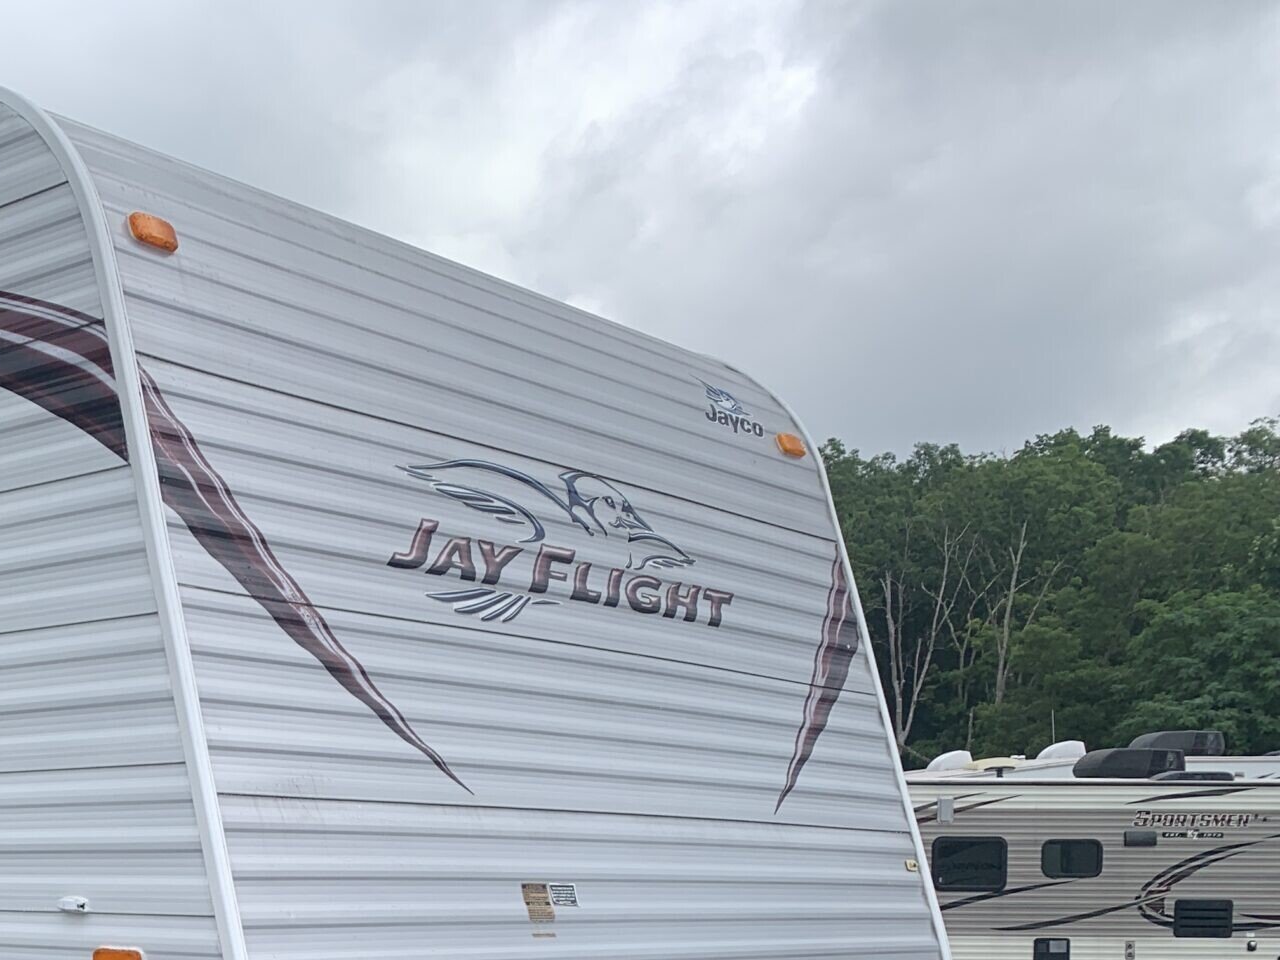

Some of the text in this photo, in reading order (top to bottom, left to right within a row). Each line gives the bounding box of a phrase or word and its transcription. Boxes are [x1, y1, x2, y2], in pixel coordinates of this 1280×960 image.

[705, 403, 764, 438] Jayco
[387, 518, 734, 628] JAY FLIGHT
[1134, 810, 1251, 827] SPORTSMEN
